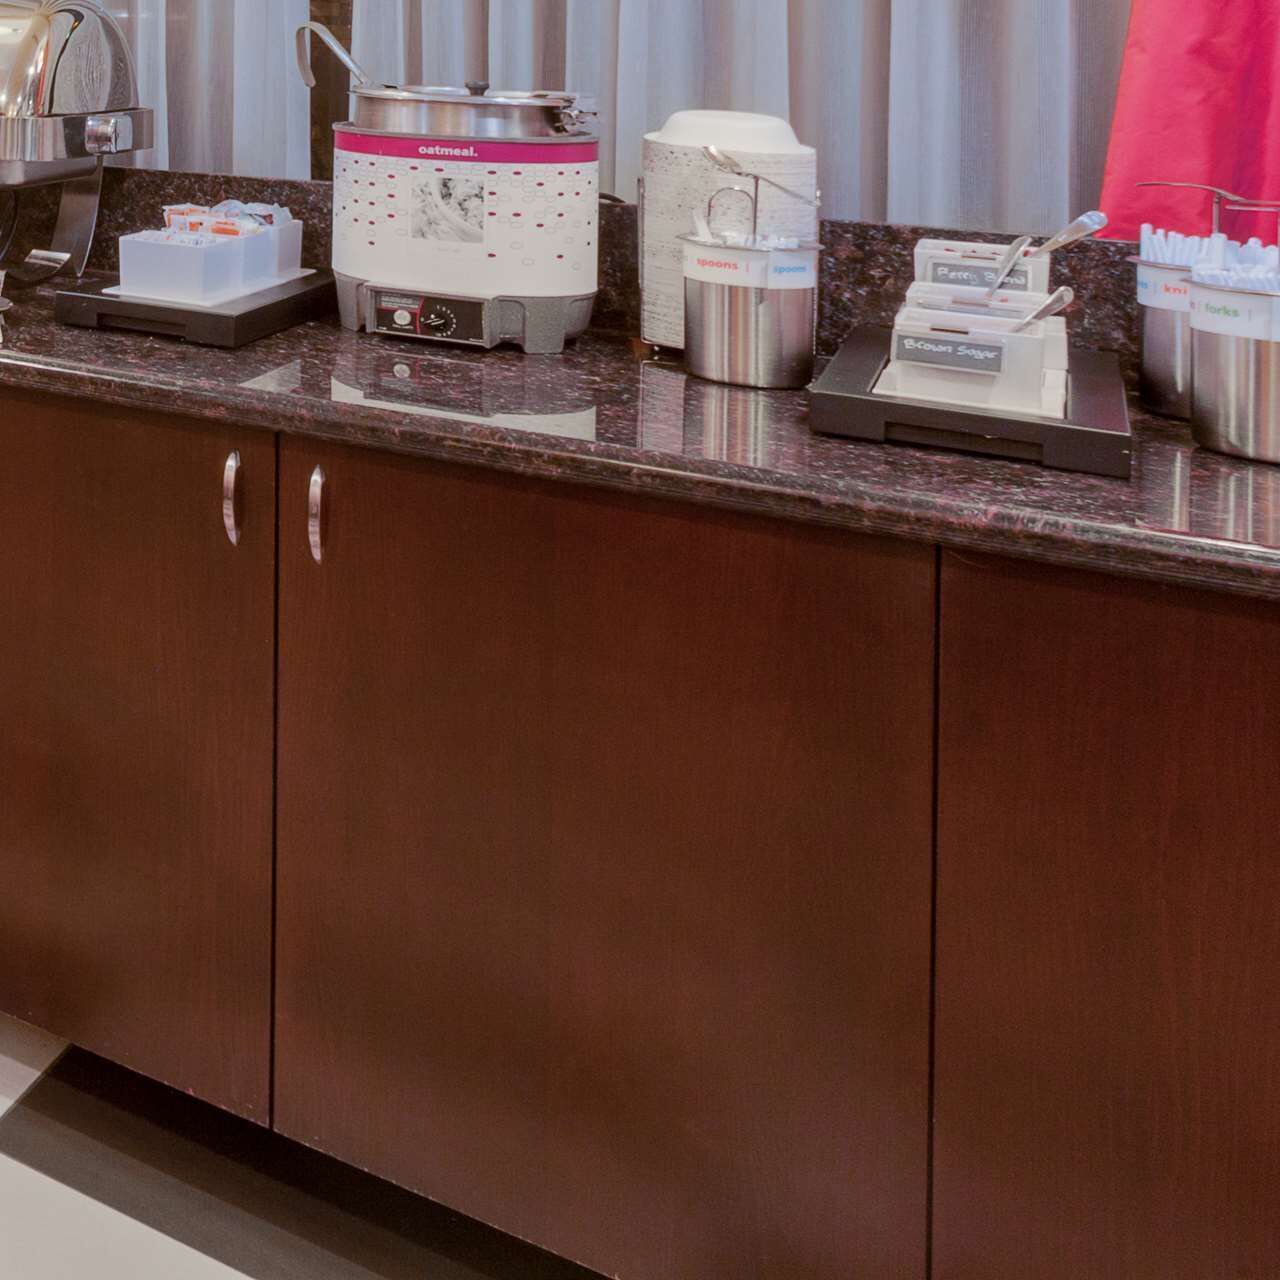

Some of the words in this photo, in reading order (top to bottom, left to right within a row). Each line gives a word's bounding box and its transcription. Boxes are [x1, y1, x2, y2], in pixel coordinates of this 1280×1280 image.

[418, 145, 479, 157] oatmeal.
[696, 257, 739, 271] spoons
[1205, 303, 1240, 318] forks
[903, 337, 953, 354] Brown
